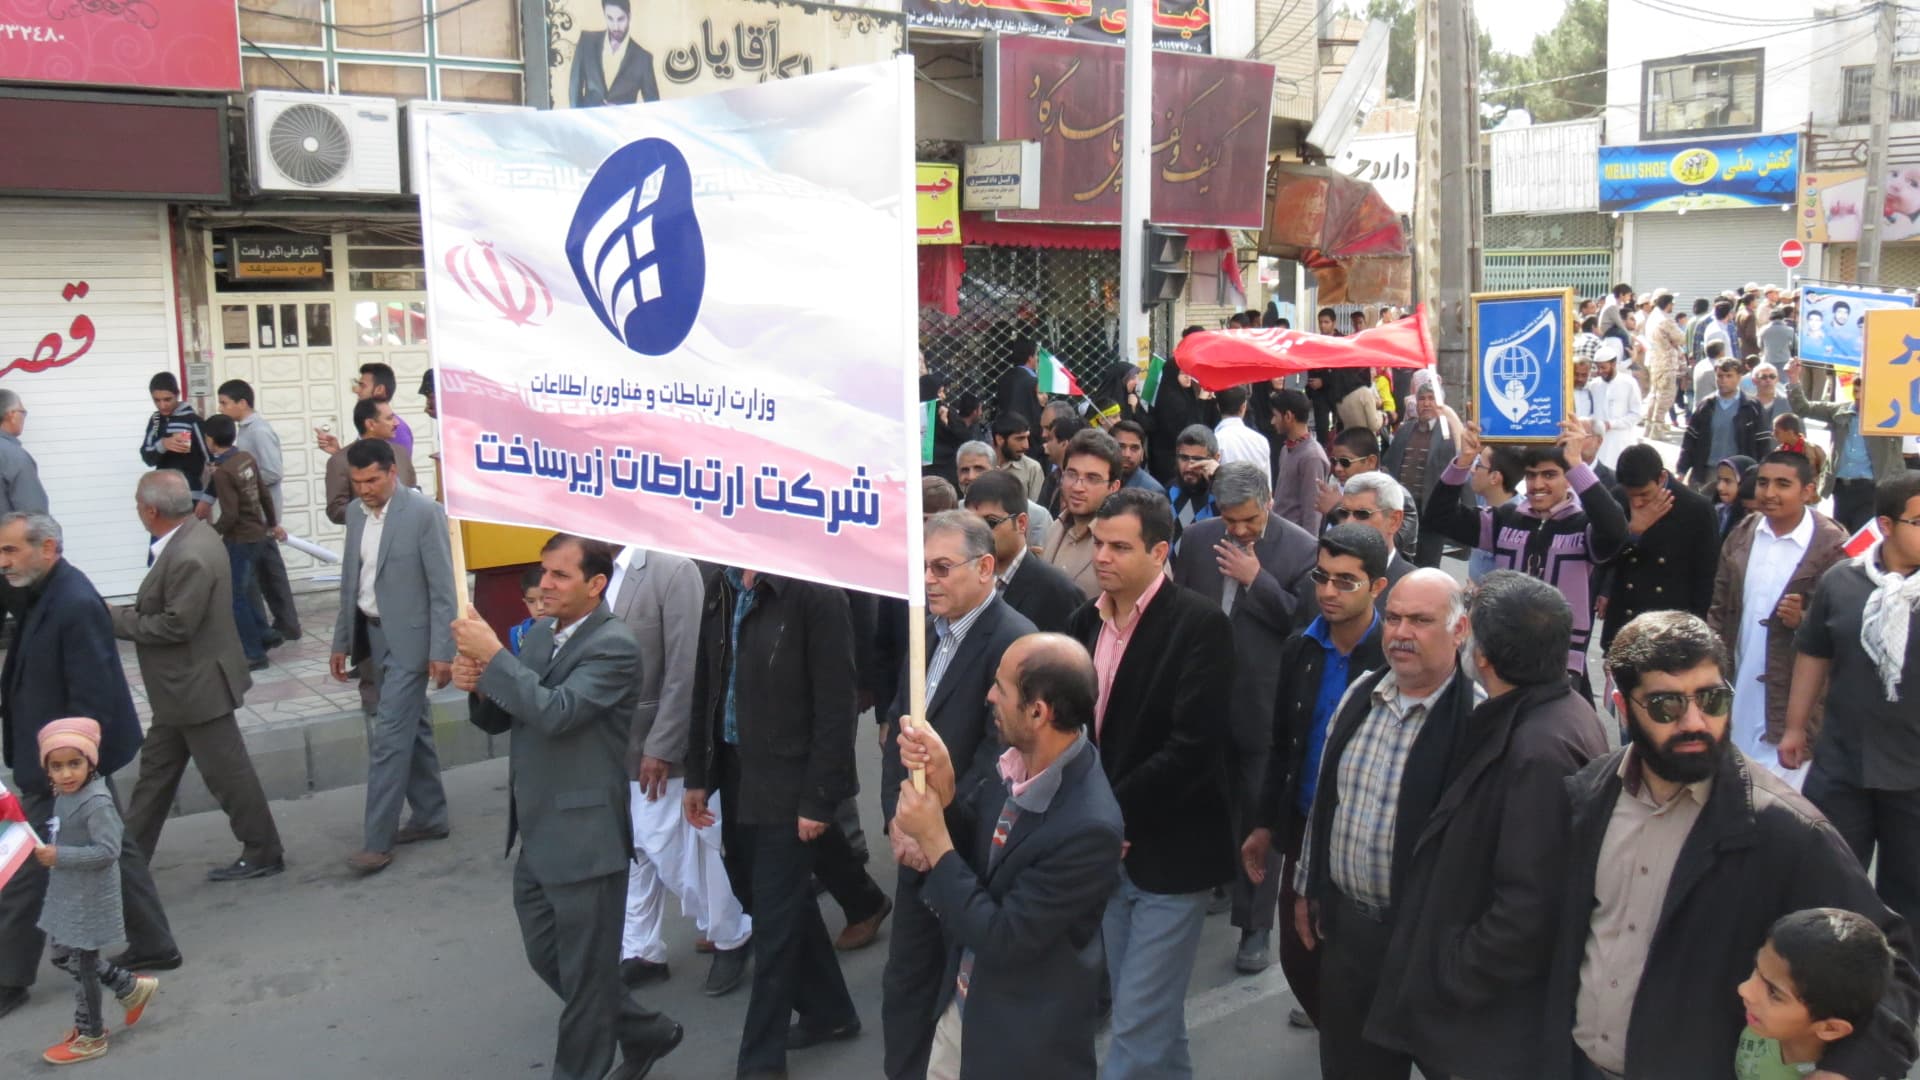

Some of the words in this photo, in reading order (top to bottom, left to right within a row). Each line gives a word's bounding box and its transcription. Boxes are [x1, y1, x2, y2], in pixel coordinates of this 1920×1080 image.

[664, 17, 780, 84] آقایان
[1345, 152, 1410, 180] داروخ
[1604, 163, 1635, 180] MELLI
[1638, 160, 1667, 178] SHOE
[1758, 148, 1793, 177] کفش
[266, 244, 283, 258] اکبر
[283, 245, 299, 258] علی
[300, 245, 319, 258] دکتر
[0, 281, 95, 378] قص
[531, 373, 587, 397] اطلاعات
[591, 379, 642, 409] فناوری
[647, 388, 656, 410] و
[660, 382, 725, 417] ارتباطات
[730, 391, 776, 422] وزارت
[474, 433, 603, 497] زیرساخت
[610, 448, 744, 516] ارتباطات
[754, 465, 880, 533] شرکت
[1501, 527, 1531, 545] BLACK
[1552, 533, 1586, 549] WHITE
